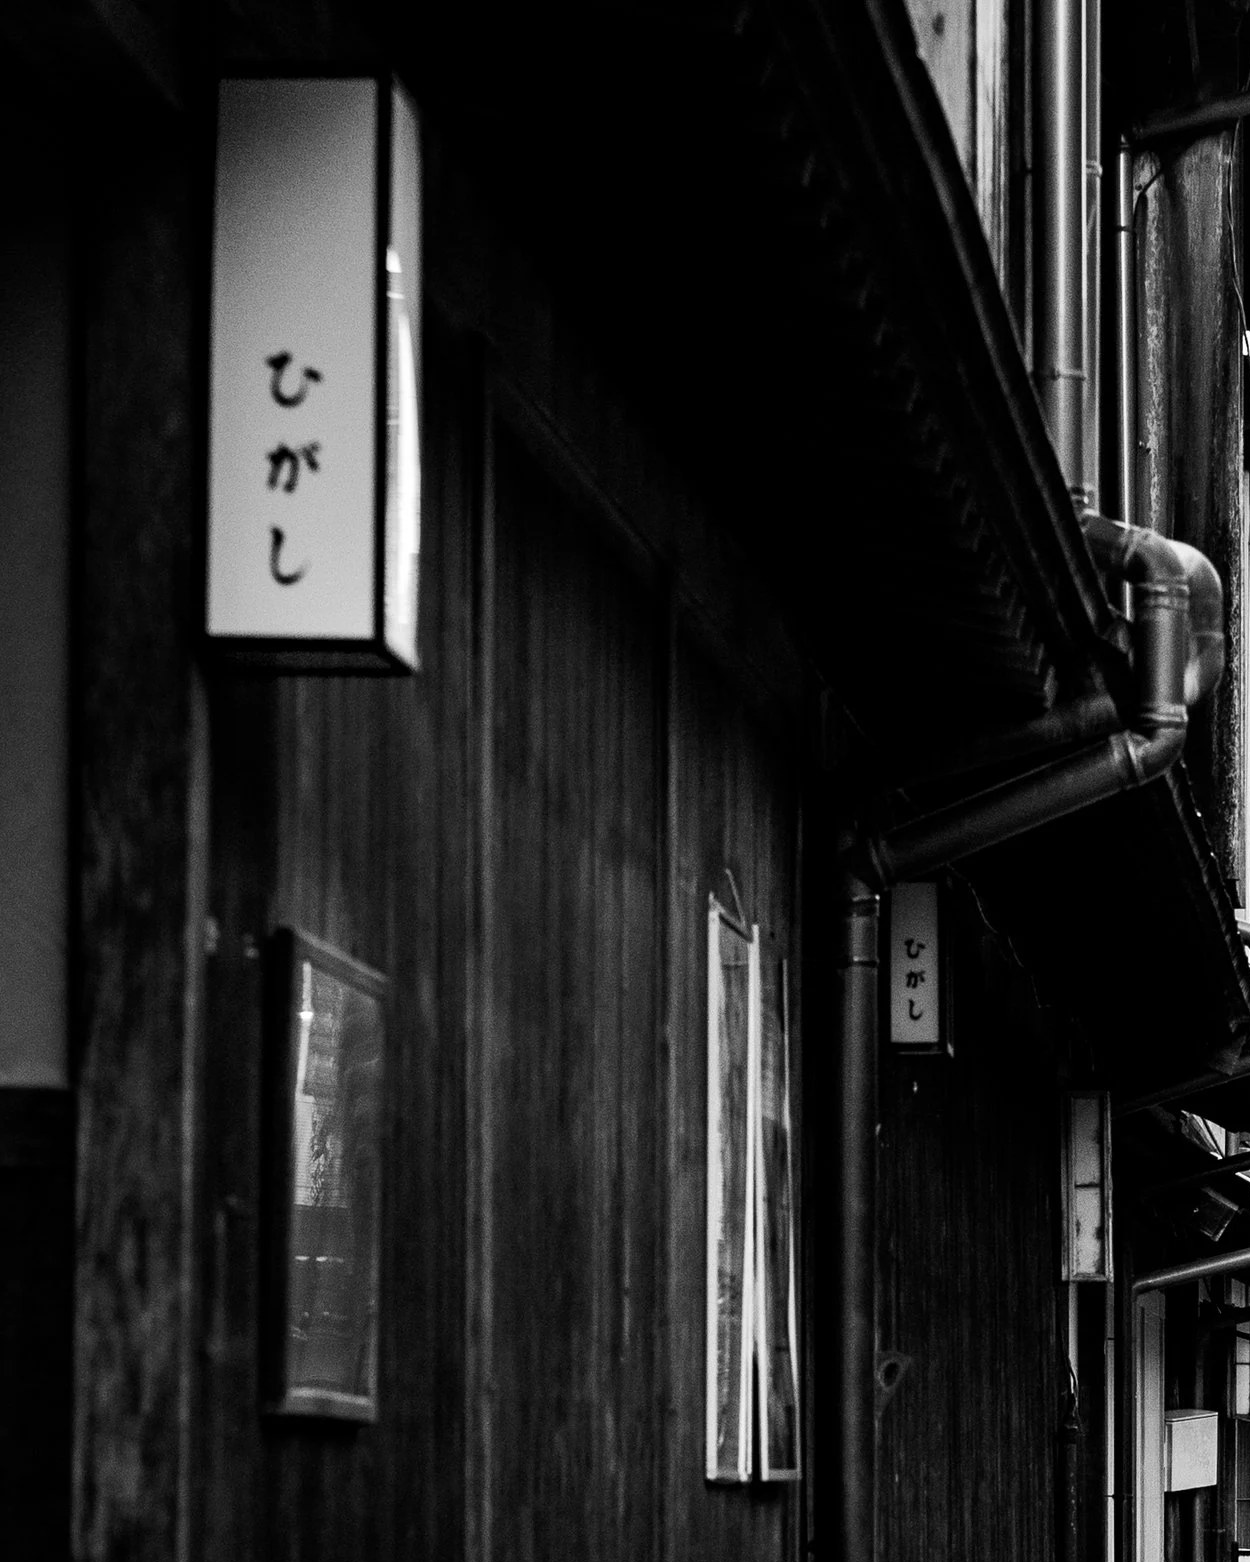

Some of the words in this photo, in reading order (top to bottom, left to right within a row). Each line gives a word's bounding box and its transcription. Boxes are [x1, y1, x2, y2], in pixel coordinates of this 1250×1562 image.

[265, 350, 323, 586] ひがし
[904, 938, 926, 1021] ひがし
